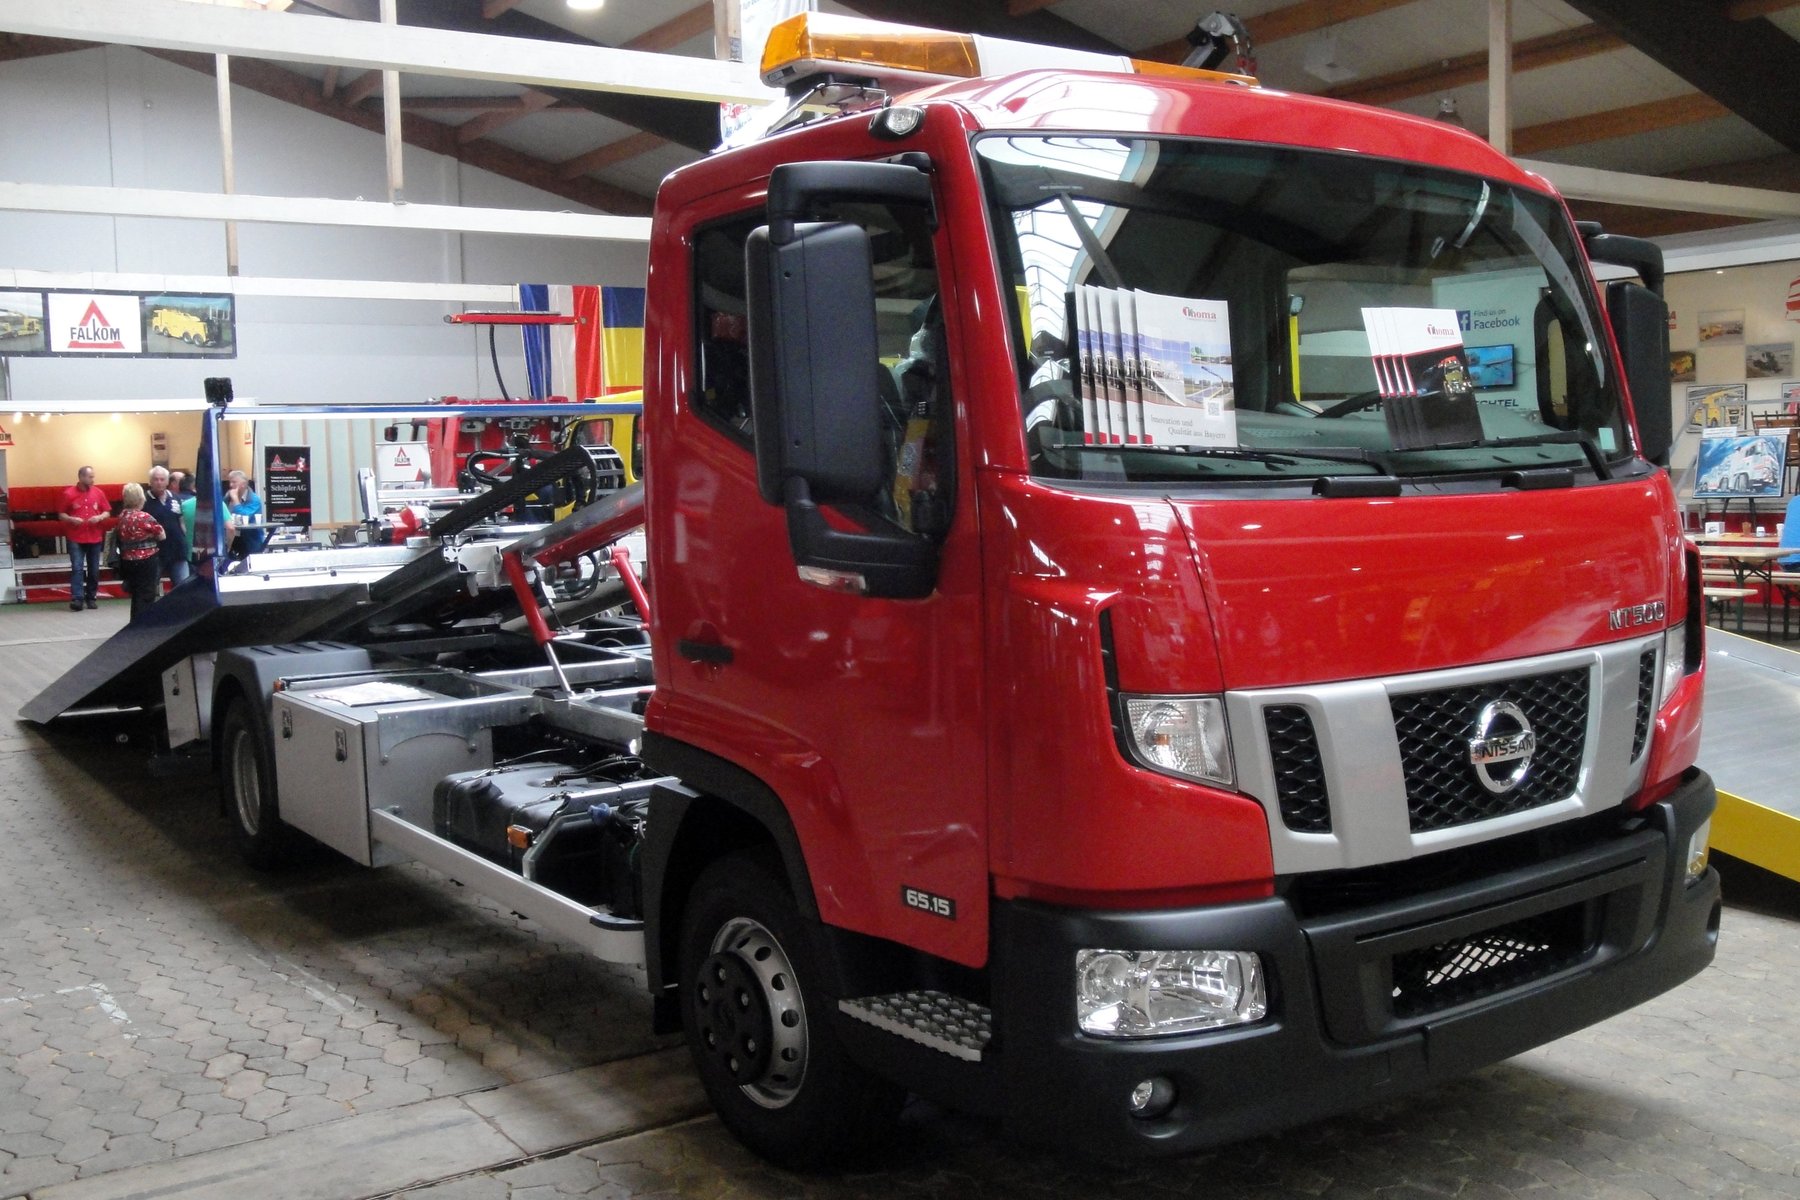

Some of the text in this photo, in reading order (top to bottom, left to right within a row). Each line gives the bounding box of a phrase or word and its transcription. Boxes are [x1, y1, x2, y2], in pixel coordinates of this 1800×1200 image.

[70, 318, 120, 342] FALKOM
[1473, 316, 1520, 330] Facebook
[1181, 419, 1193, 427] und
[1482, 737, 1533, 757] NISSAN
[906, 889, 950, 916] 65.15
